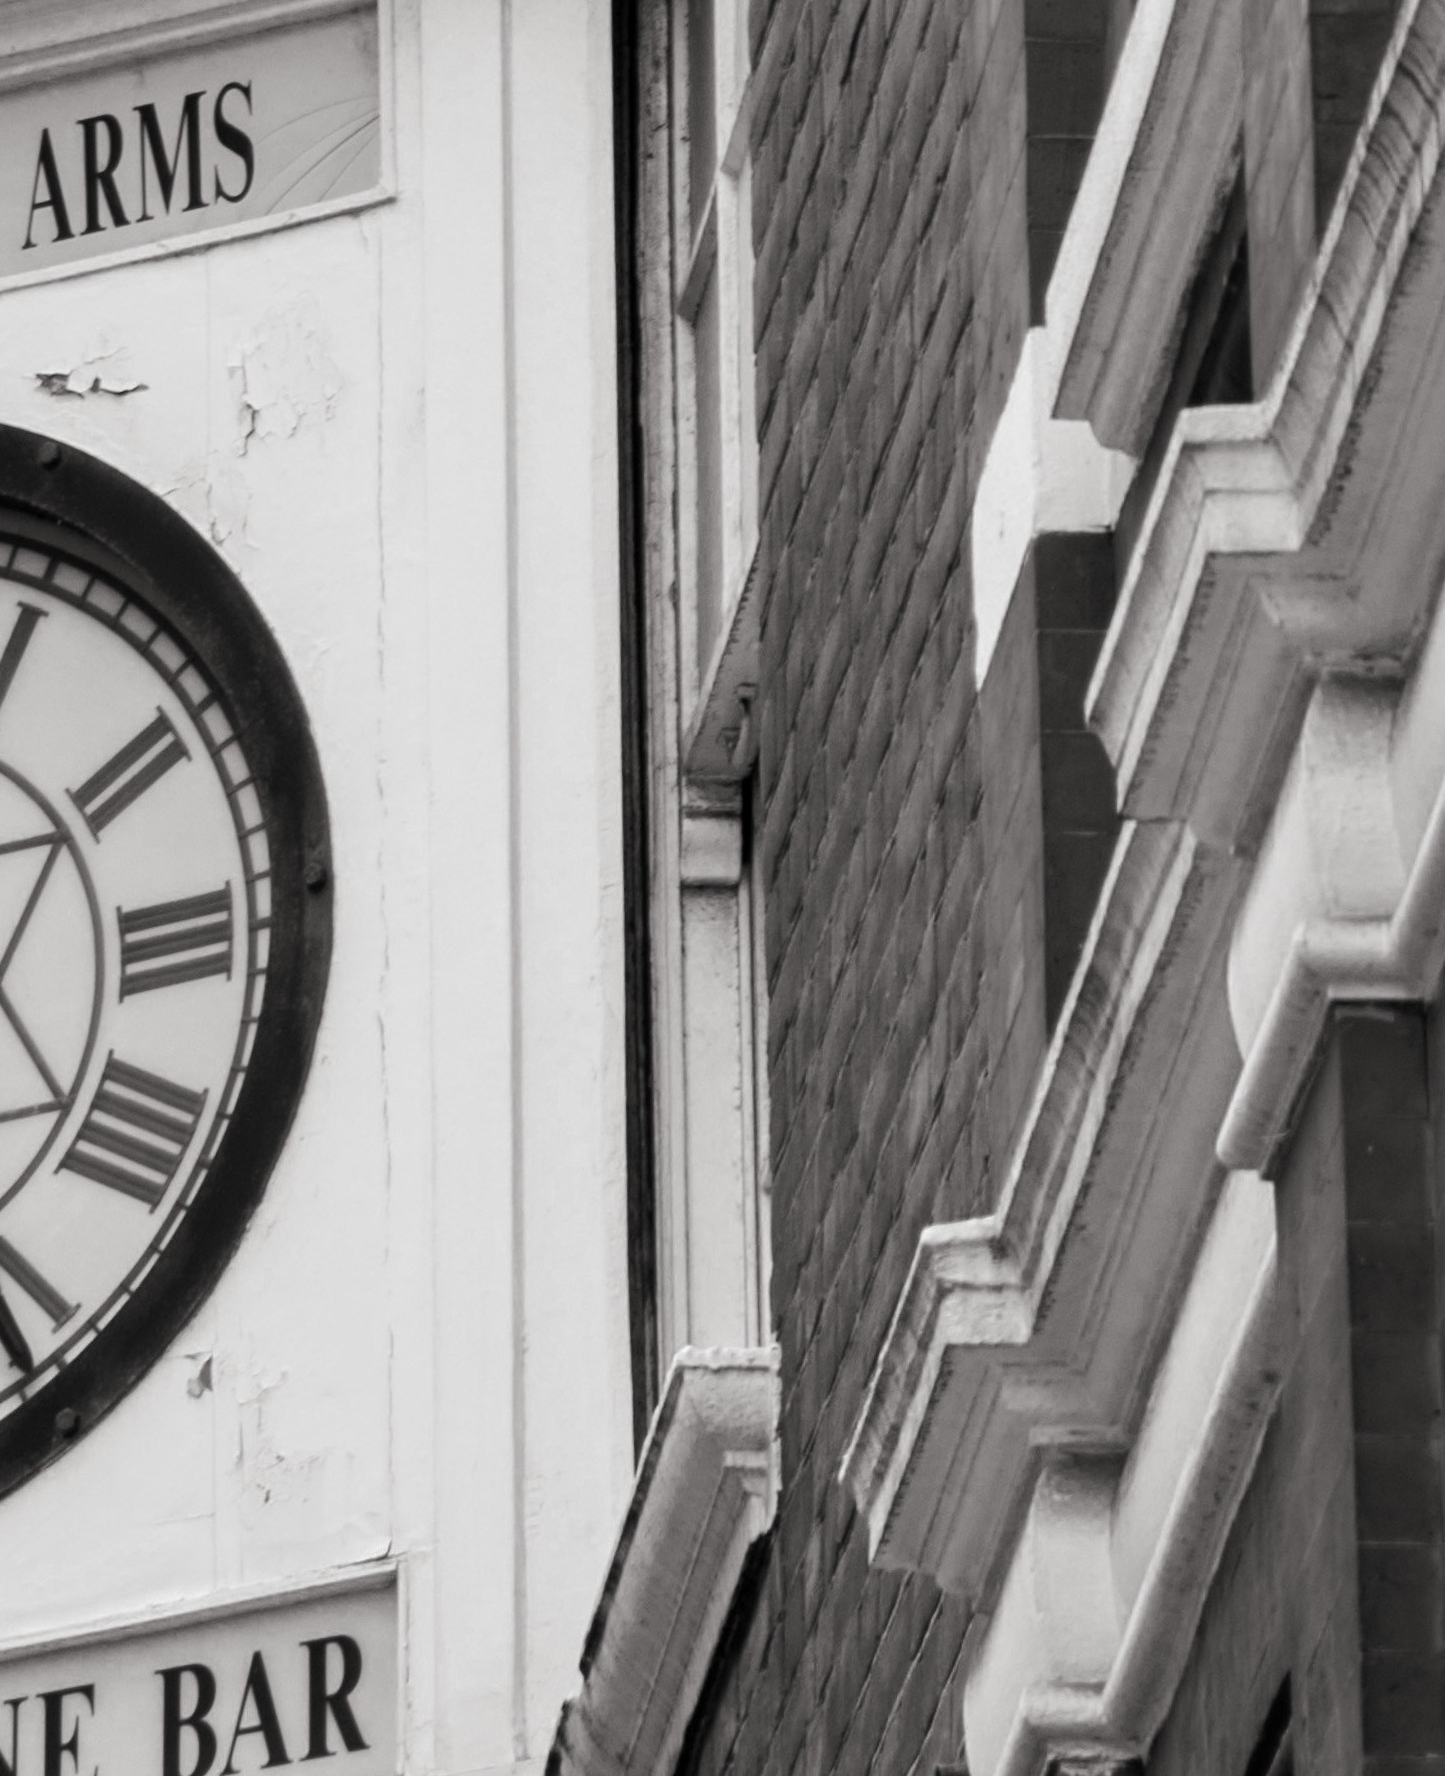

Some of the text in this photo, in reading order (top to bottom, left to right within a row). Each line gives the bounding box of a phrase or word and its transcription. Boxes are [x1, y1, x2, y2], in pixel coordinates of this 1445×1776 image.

[22, 82, 254, 249] ARMS
[65, 705, 192, 844] II
[116, 880, 234, 1004] III
[53, 1049, 209, 1214] IIII
